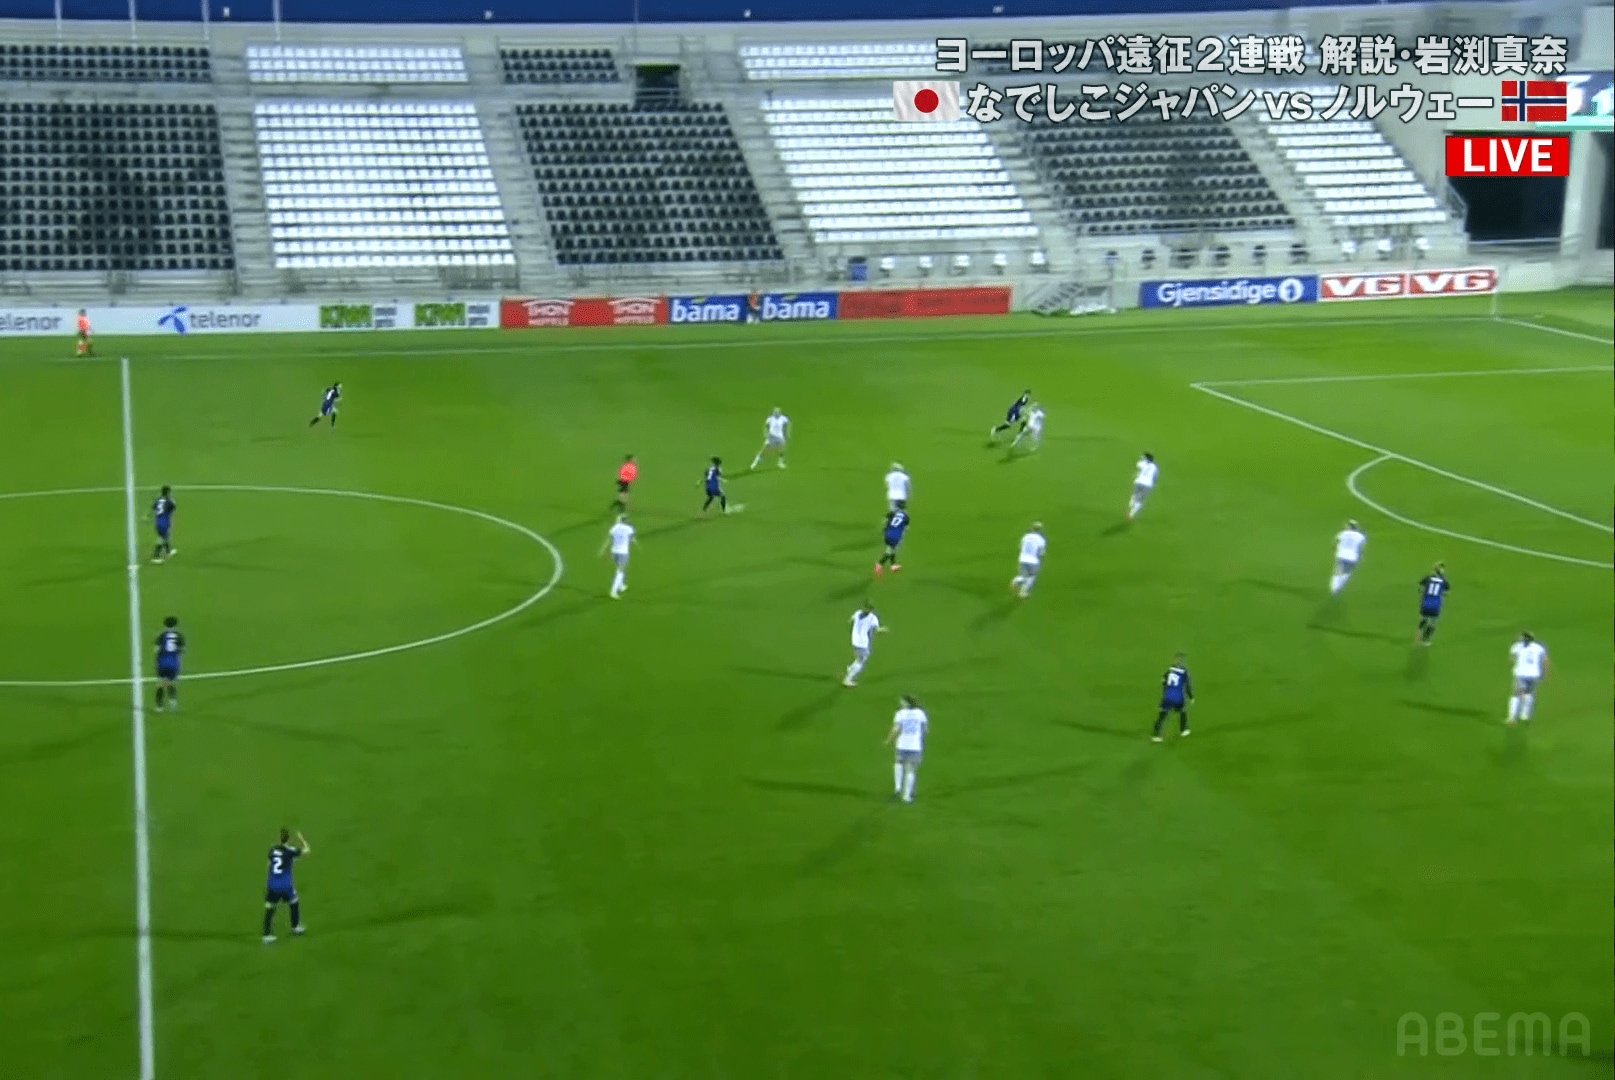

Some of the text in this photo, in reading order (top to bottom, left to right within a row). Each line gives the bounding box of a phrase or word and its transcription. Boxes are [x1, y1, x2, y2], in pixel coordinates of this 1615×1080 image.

[1325, 276, 1401, 296] VG
[1414, 271, 1490, 293] VG
[1157, 281, 1277, 306] Gjensidige
[671, 299, 741, 322] bama
[762, 297, 830, 319] bama
[189, 311, 261, 329] telenor
[1428, 582, 1441, 596] 11
[273, 856, 283, 874] 2
